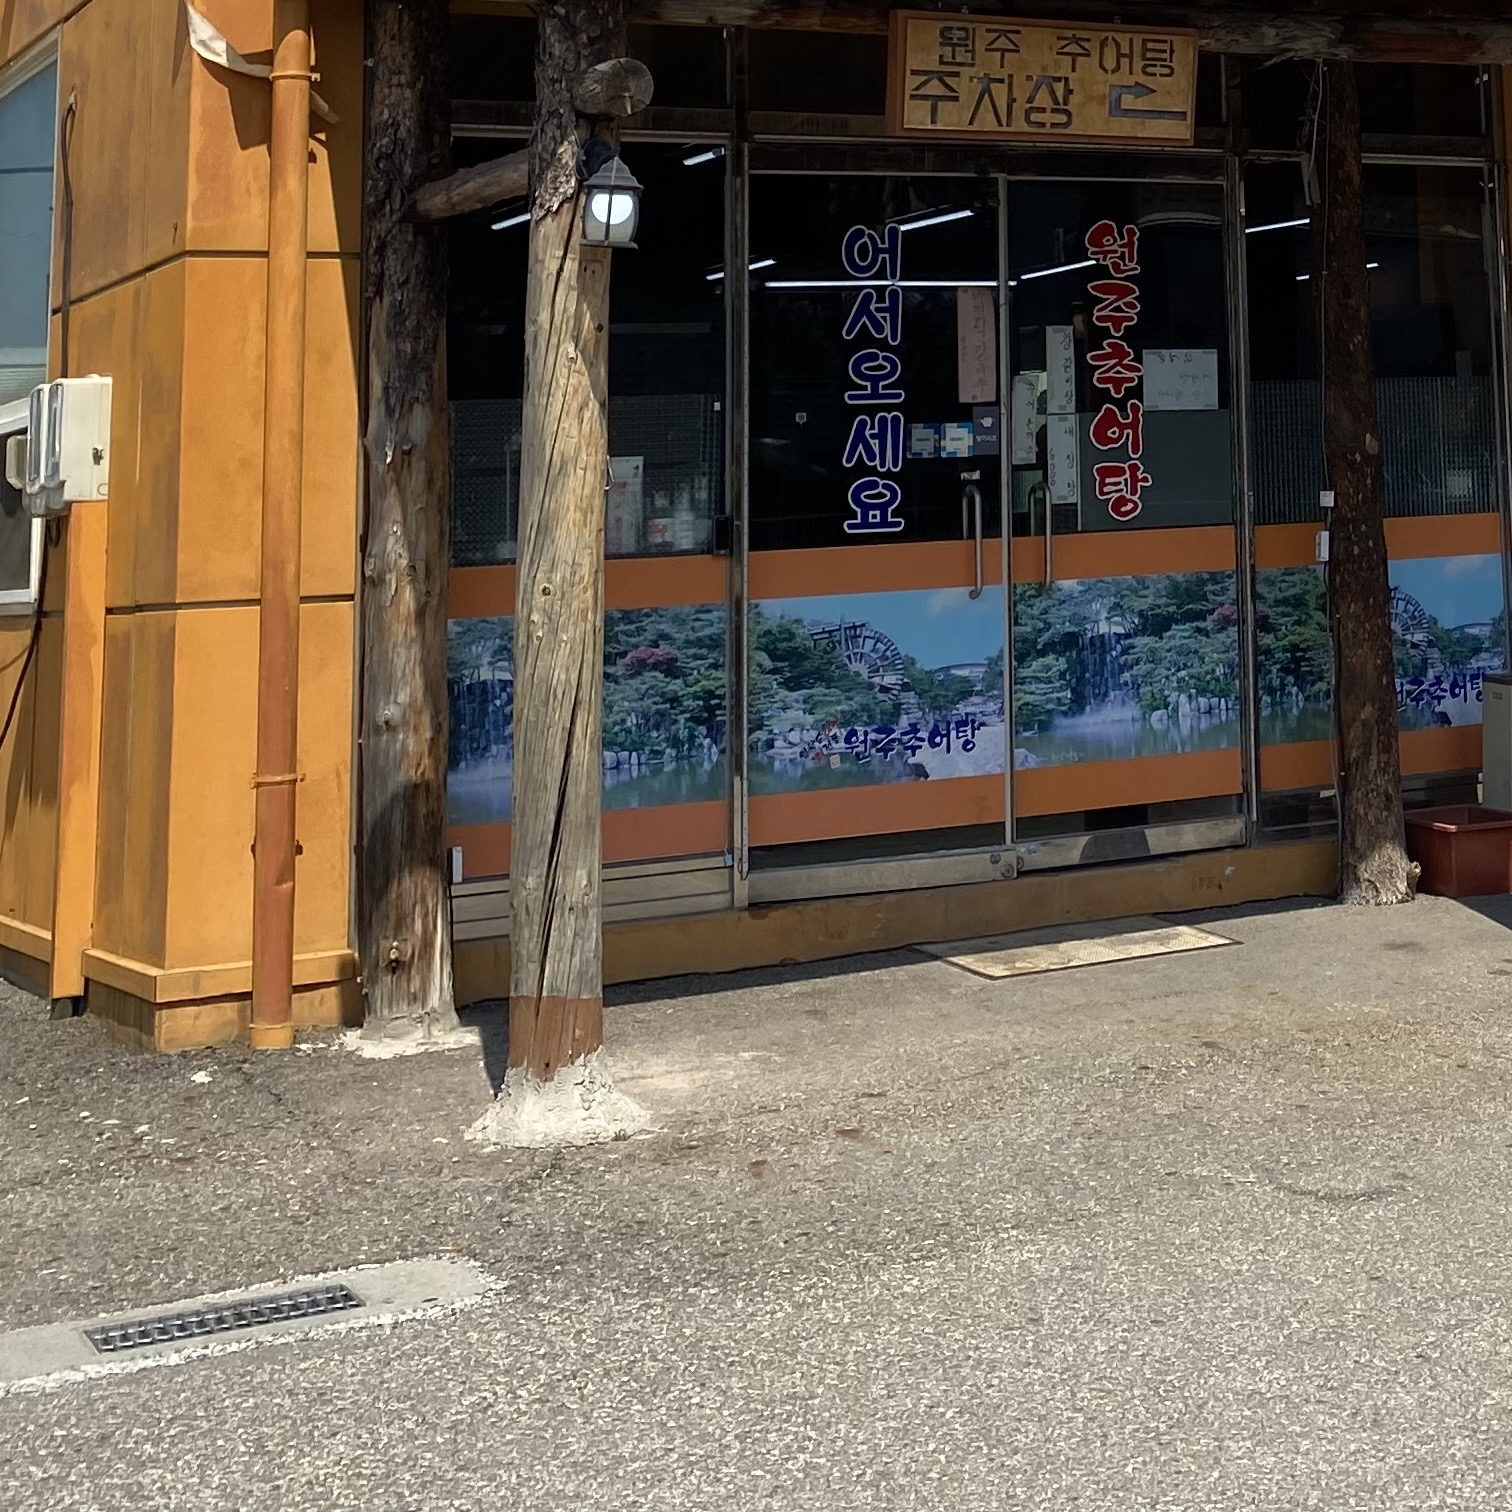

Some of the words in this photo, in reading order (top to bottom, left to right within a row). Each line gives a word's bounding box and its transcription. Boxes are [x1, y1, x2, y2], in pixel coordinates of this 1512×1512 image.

[939, 25, 1022, 69] 원주
[1056, 33, 1176, 78] 추어탕
[909, 68, 1075, 130] 주차장
[841, 223, 905, 534] 어서오세요
[1083, 219, 1152, 522] 원주추어탕
[843, 717, 984, 764] 원주추어탕
